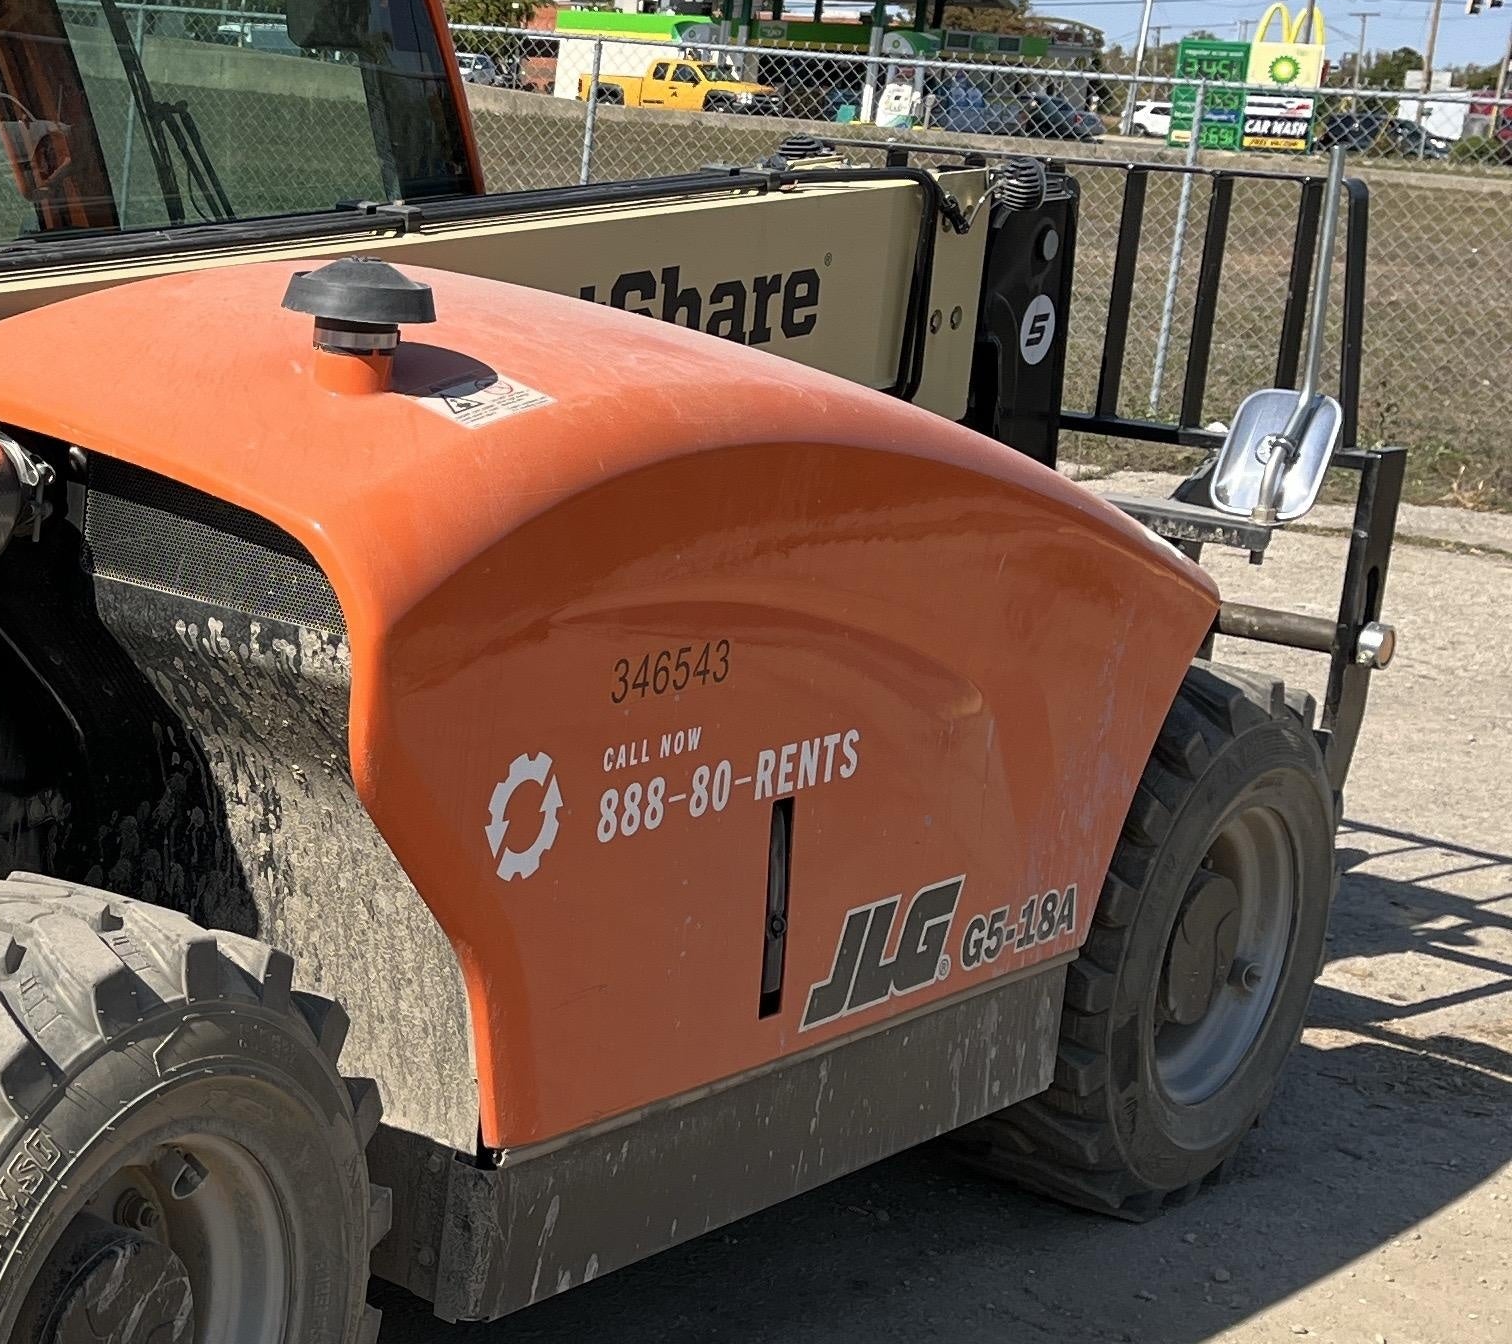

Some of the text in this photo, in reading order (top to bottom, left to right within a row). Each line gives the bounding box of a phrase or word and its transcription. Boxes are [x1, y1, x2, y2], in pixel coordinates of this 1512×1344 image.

[1244, 119, 1308, 136] CAR WASH
[610, 639, 730, 704] 346543
[603, 726, 702, 772] CALL NOW
[596, 728, 860, 844] 888-80-RENTS
[798, 874, 1078, 1033] JLG G5-18A
